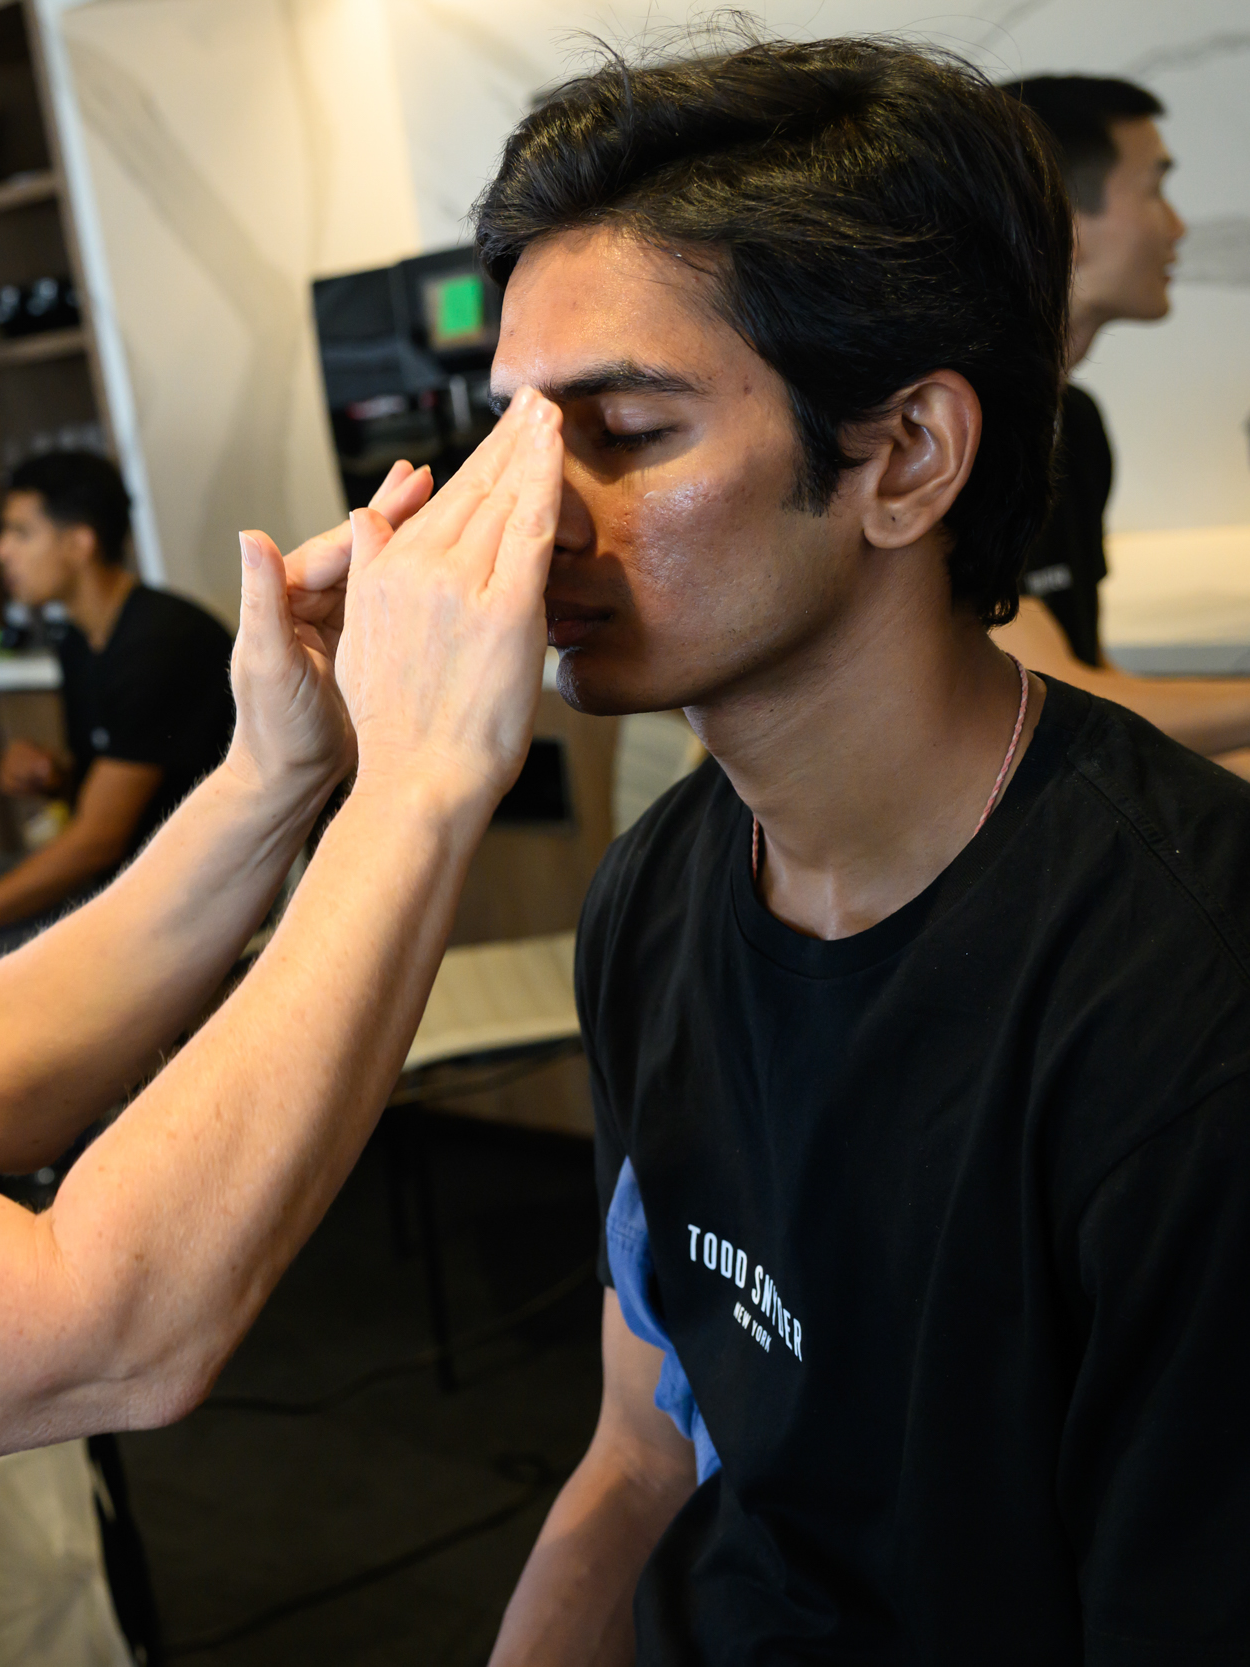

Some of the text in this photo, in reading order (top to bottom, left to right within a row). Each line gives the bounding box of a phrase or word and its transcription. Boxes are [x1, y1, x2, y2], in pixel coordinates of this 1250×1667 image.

[687, 1223, 803, 1363] TODD SNYDER
[733, 1301, 772, 1353] NEW YORK
